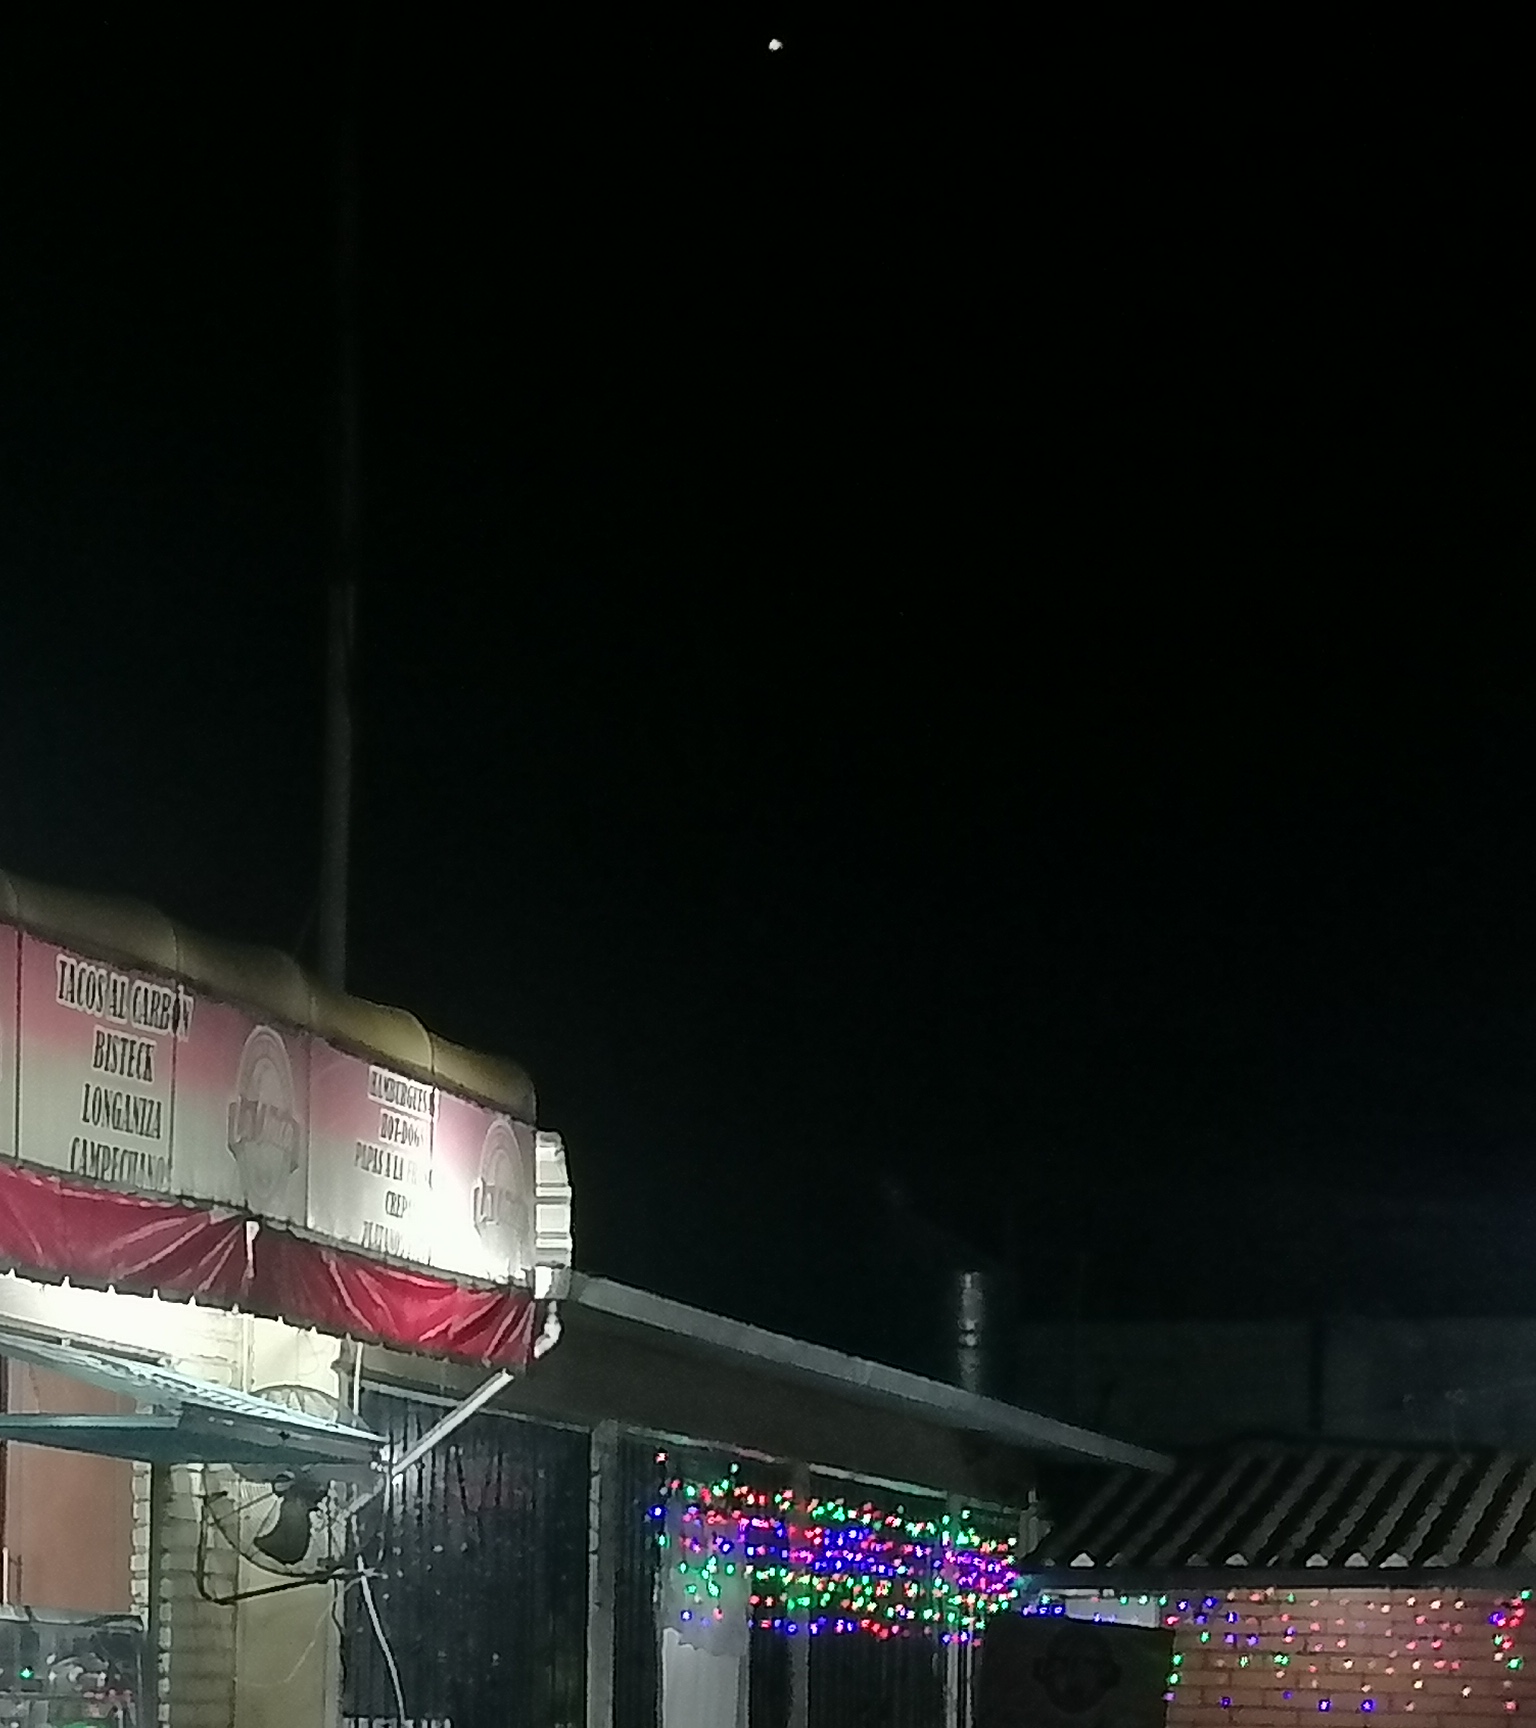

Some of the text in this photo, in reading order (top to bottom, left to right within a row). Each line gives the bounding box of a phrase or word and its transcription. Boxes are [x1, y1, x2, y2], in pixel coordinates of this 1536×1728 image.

[58, 959, 104, 1014] TACOS
[110, 974, 128, 1020] AL
[93, 1029, 155, 1083] BISTECK
